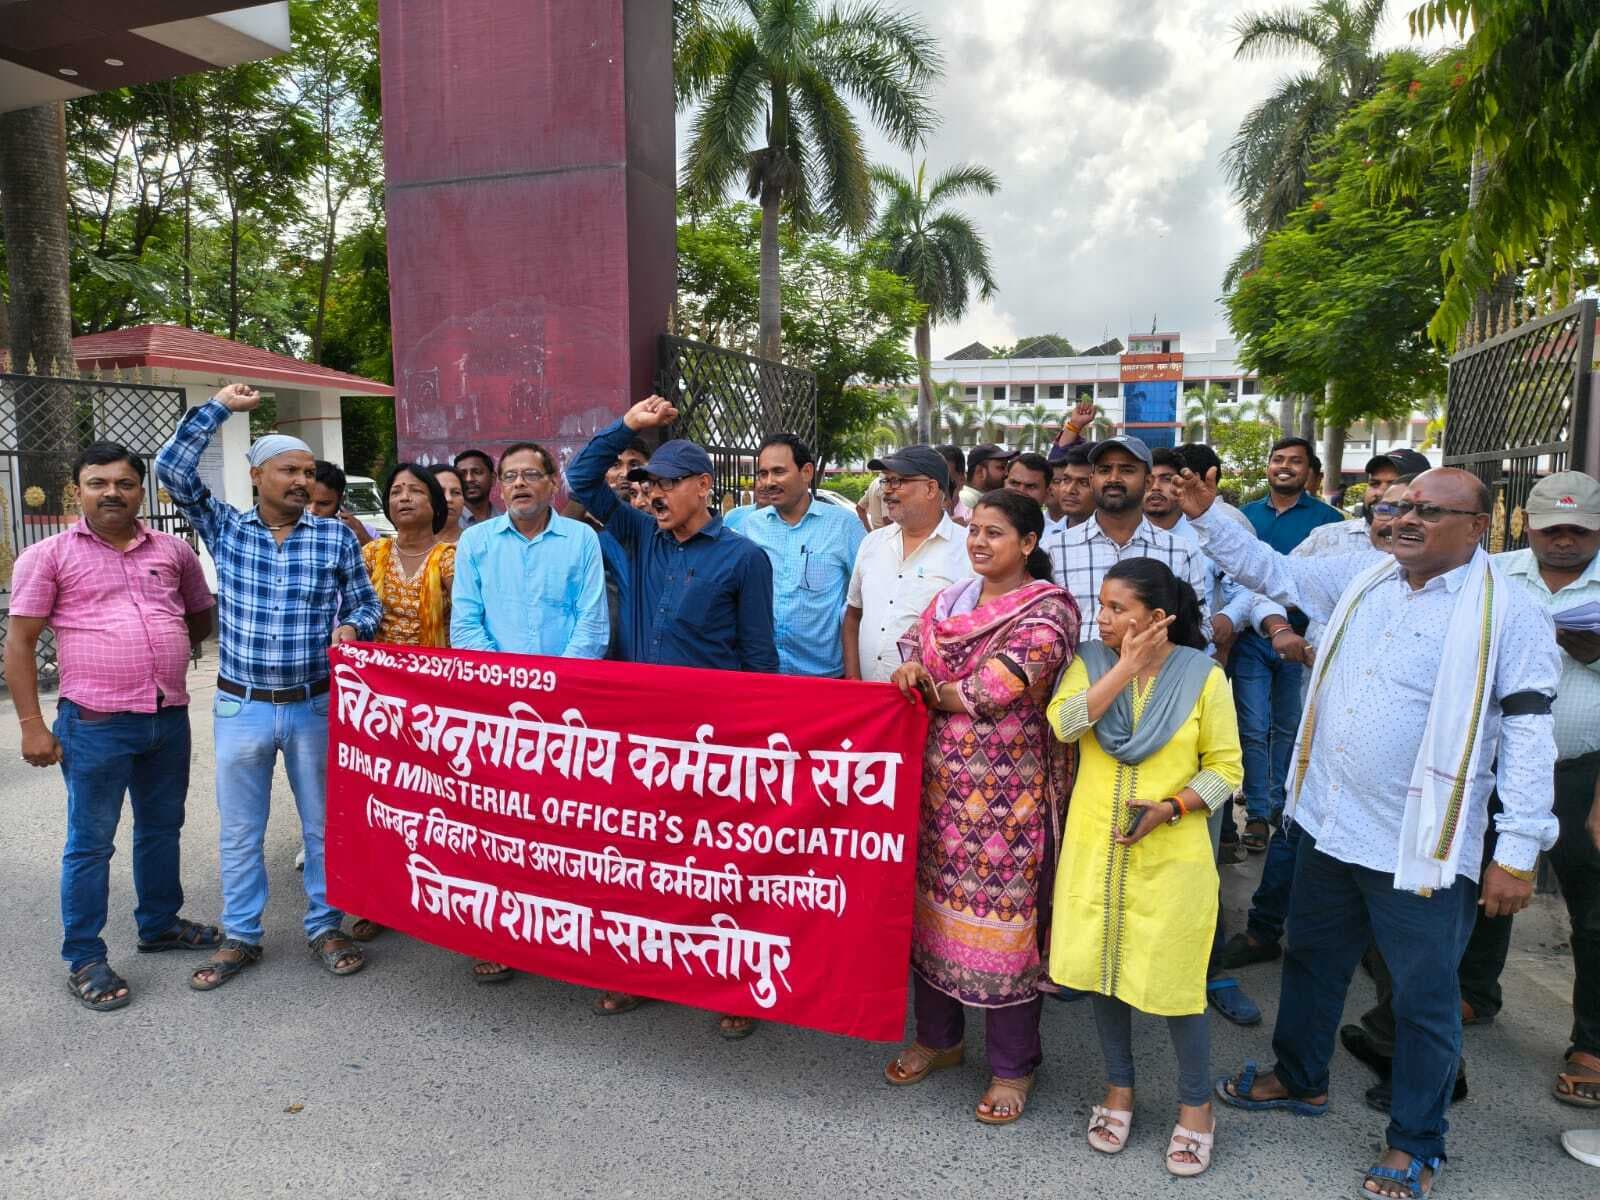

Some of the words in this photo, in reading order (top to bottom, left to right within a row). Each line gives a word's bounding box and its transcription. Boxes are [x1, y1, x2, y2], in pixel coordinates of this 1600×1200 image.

[334, 664, 409, 744] बिहार
[411, 700, 622, 785] अनुसचिवीय
[627, 723, 802, 806] कर्मचारी
[808, 738, 904, 811] संघ
[338, 742, 391, 785] BIHAR
[392, 761, 536, 821] MINISTERIAL
[692, 819, 905, 863] ASSOCIATION
[405, 852, 500, 933] जिला
[423, 807, 478, 857] बिहार
[479, 828, 526, 868] राज्य
[528, 840, 647, 891] अराजपत्रित
[649, 855, 744, 905] कर्मचारी
[746, 868, 847, 918] महासंघ)
